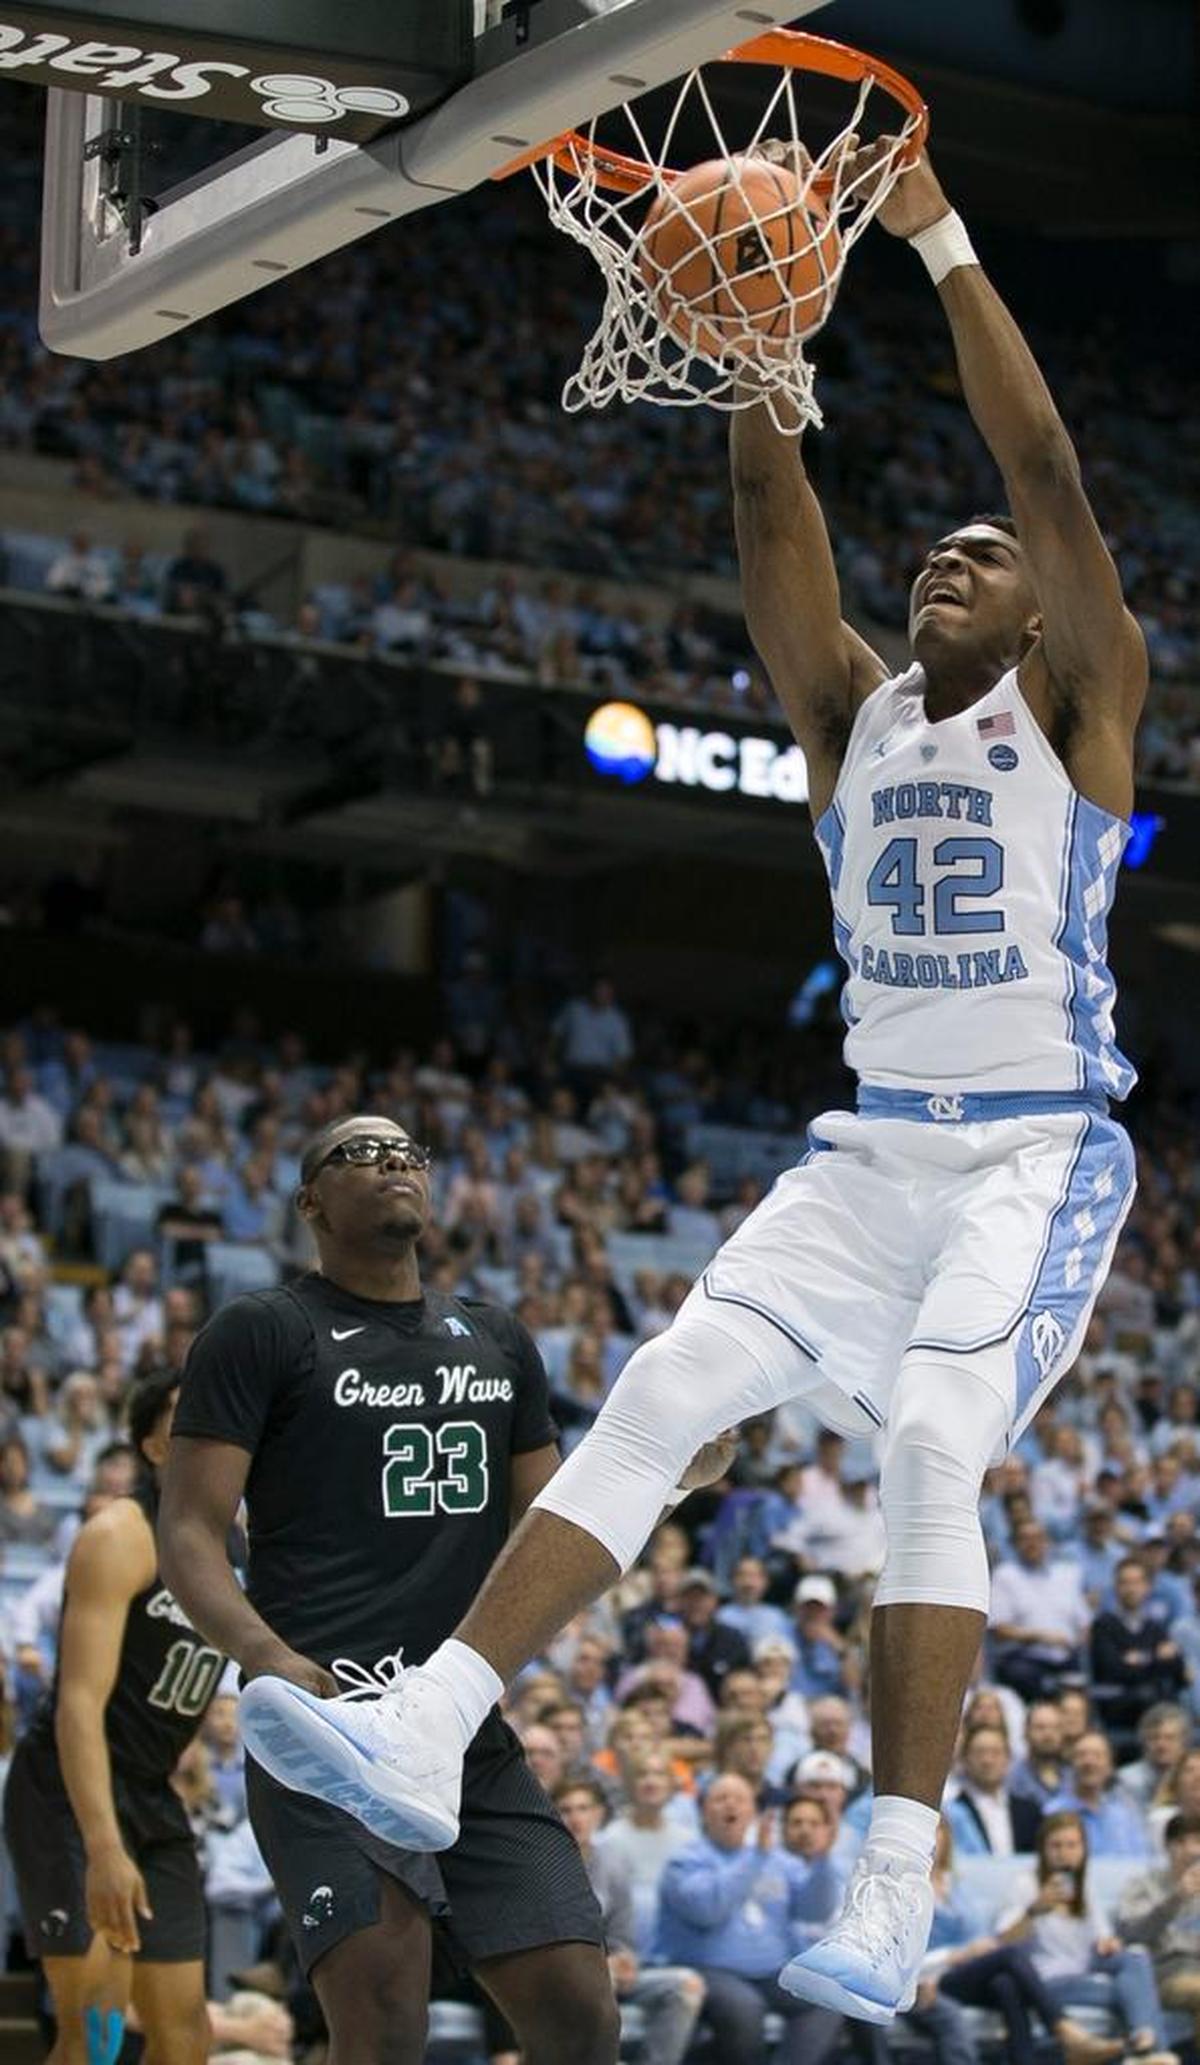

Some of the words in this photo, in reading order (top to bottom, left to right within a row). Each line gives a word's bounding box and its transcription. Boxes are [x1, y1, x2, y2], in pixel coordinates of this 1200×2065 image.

[655, 722, 738, 792] NC
[872, 781, 993, 828] NORTH
[867, 837, 1005, 936] 42
[861, 944, 1029, 989] CAROLINA
[334, 1368, 425, 1407] Green
[435, 1364, 513, 1404] Wave
[382, 1421, 489, 1518] 23
[148, 1640, 222, 1717] 10
